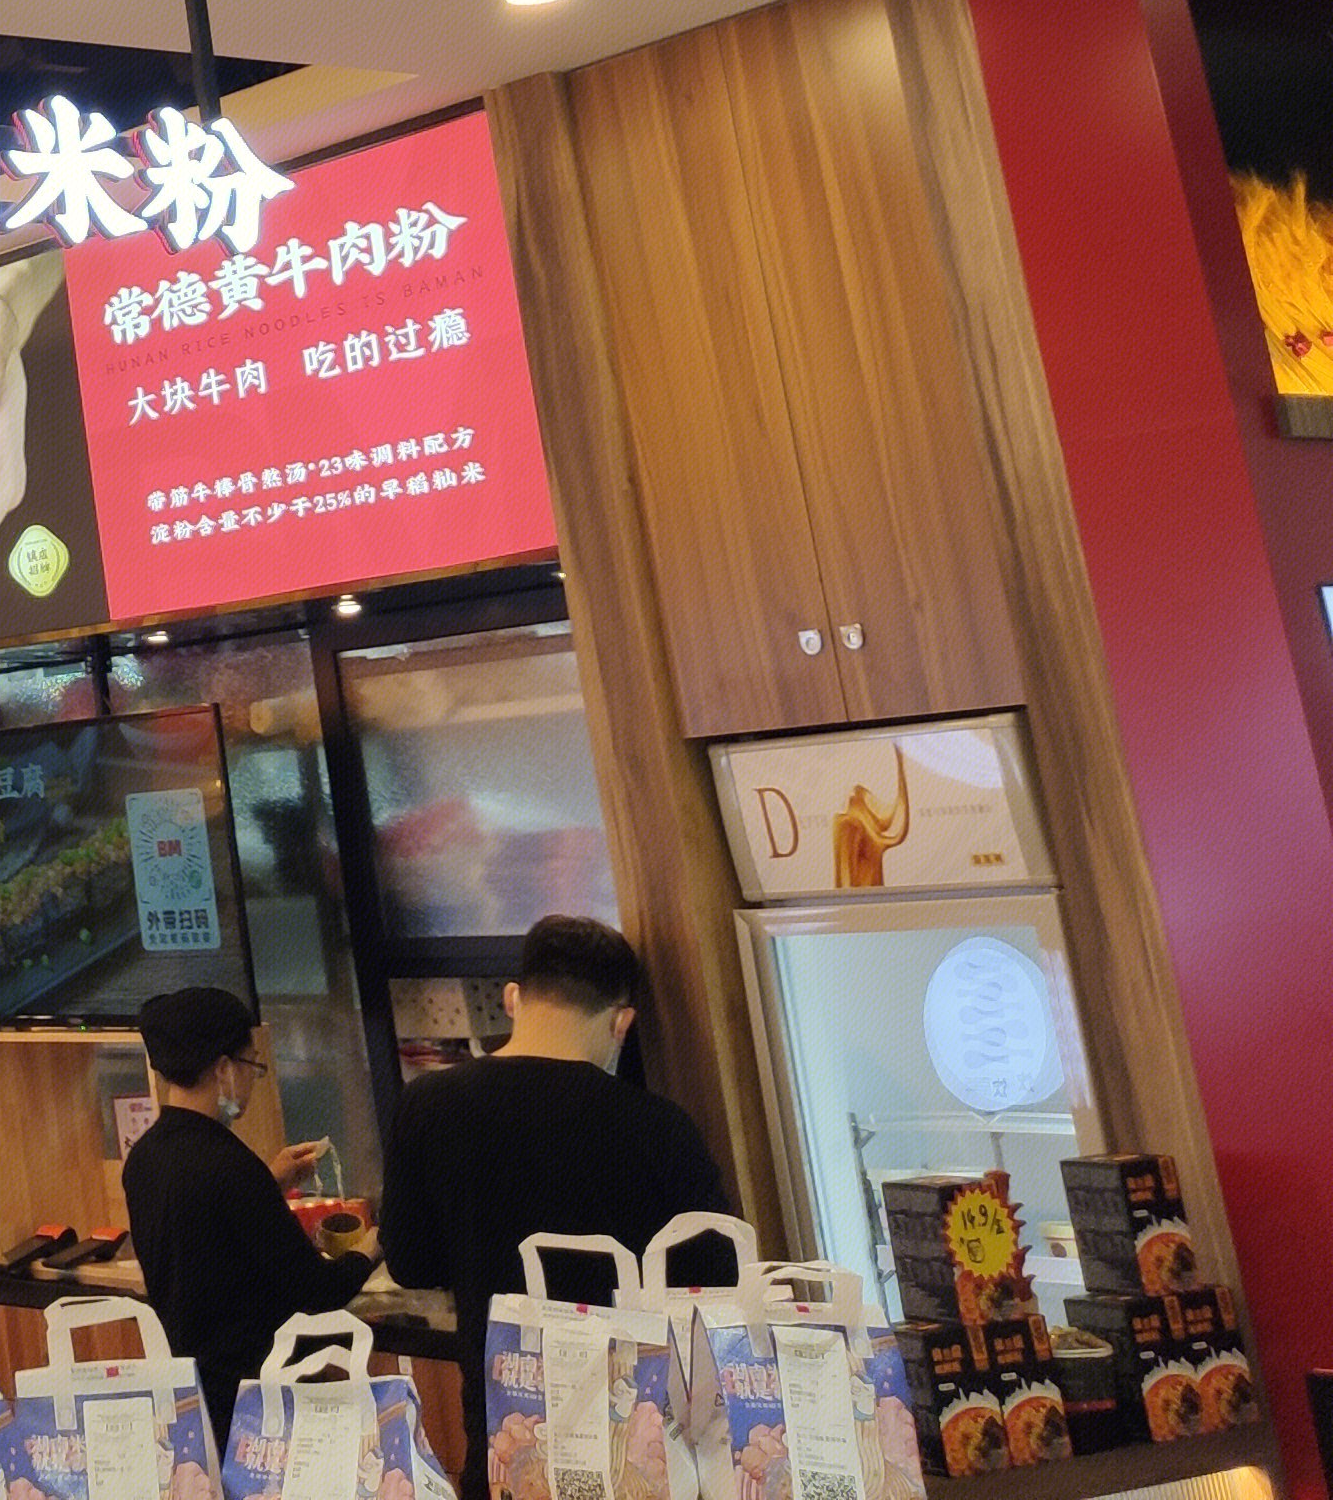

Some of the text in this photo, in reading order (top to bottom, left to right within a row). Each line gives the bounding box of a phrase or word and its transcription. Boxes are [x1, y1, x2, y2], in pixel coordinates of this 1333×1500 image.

[102, 201, 468, 346] 常德黄牛肉粉
[105, 265, 485, 376] HUNAN RICE NOODLES IS BAMAN
[128, 306, 473, 427] 大块牛肉 吃的过瘾
